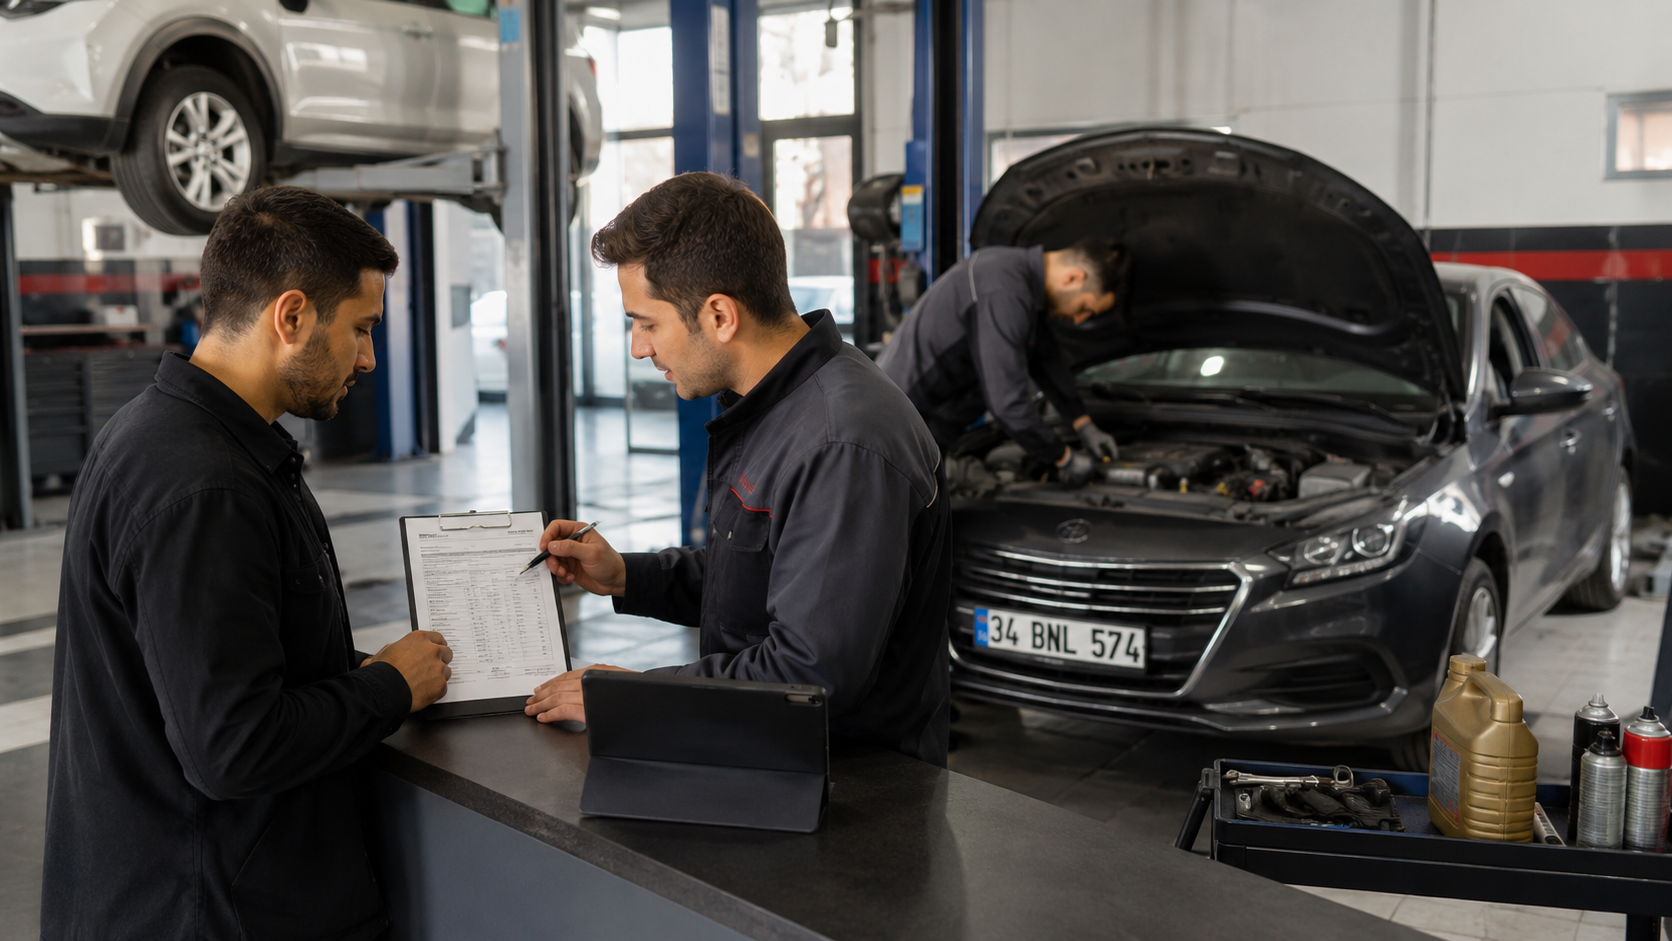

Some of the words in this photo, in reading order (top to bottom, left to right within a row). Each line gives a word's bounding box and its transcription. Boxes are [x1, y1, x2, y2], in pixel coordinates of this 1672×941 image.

[991, 616, 1018, 646] 34
[1032, 621, 1077, 655] BNL
[1091, 628, 1140, 663] 574
